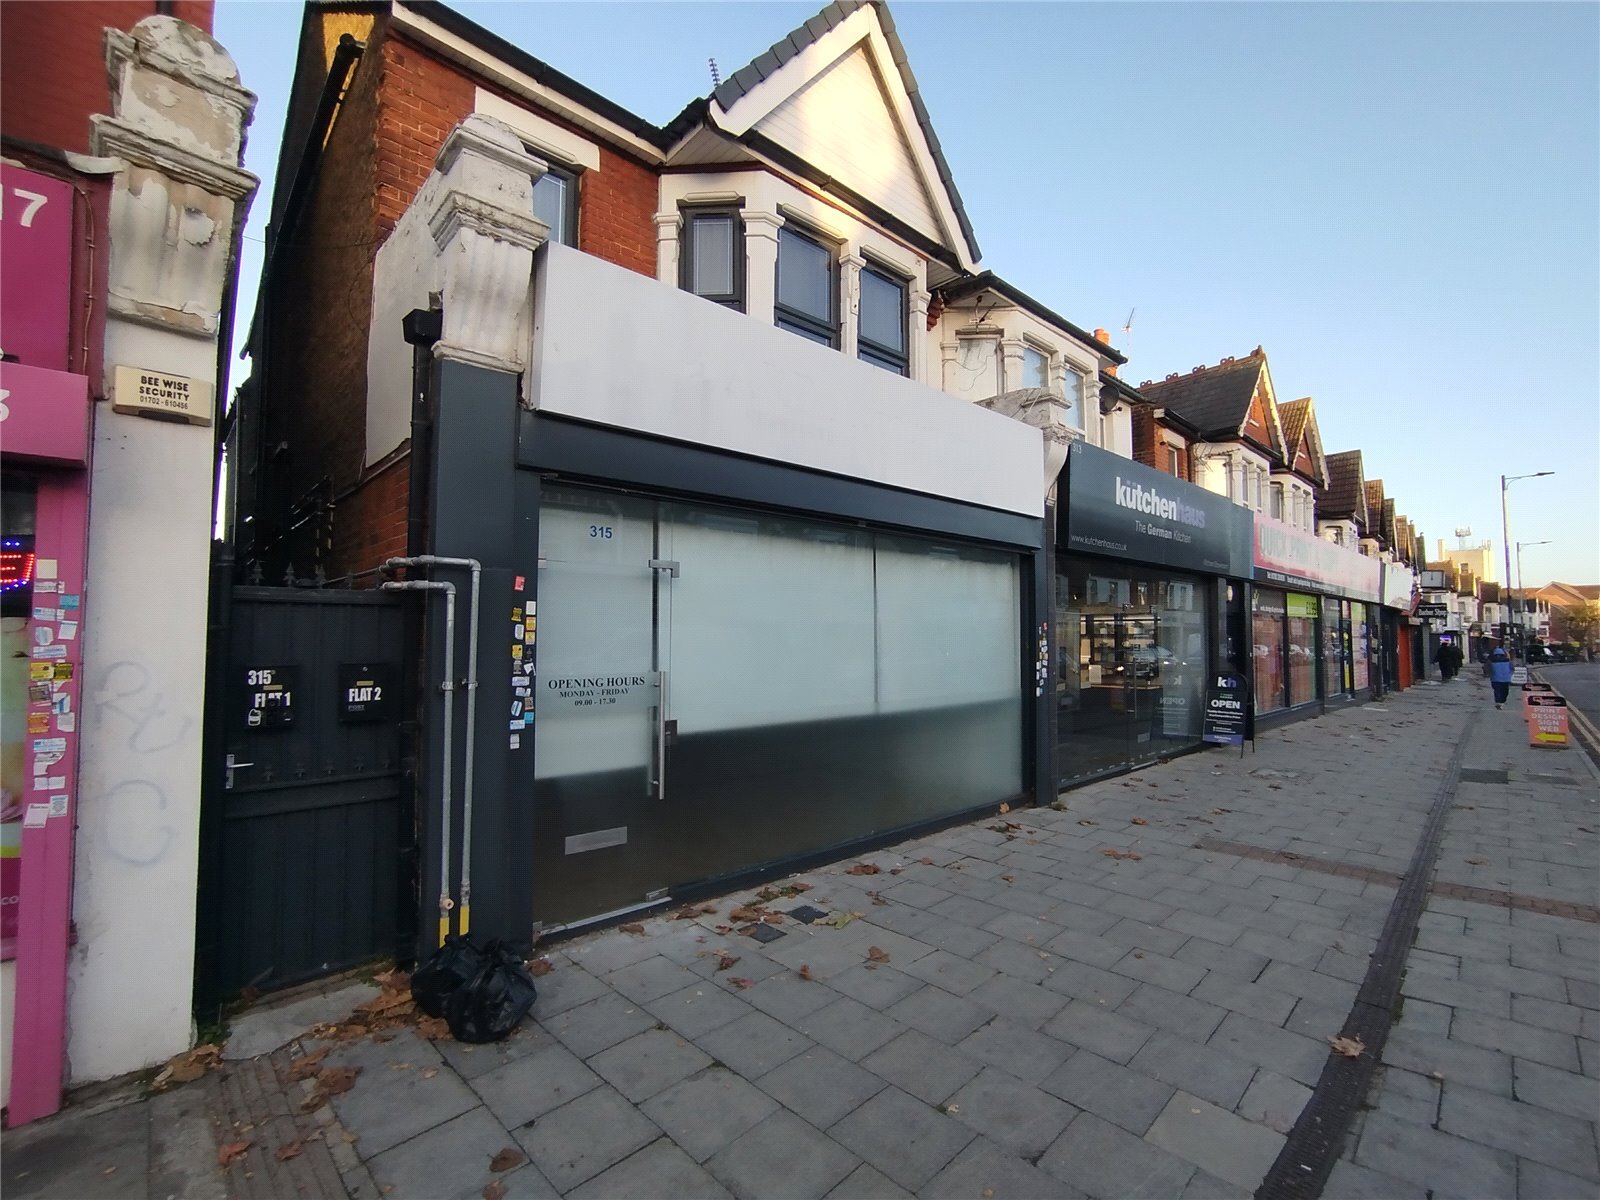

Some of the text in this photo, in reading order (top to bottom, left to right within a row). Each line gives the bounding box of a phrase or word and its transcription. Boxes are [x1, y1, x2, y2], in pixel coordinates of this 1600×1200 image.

[141, 376, 188, 391] BEE WISE
[139, 386, 189, 401] SECURITY
[590, 525, 613, 539] 315
[1135, 520, 1146, 533] The
[1147, 523, 1173, 540] German
[248, 670, 272, 686] 315
[548, 676, 646, 690] OPENING HOURS
[1217, 676, 1236, 687] kh
[284, 692, 291, 706] 1
[348, 687, 382, 702] FLAT 2
[559, 690, 595, 698] MONDAY
[601, 687, 630, 696] FRIDAY
[1211, 700, 1240, 709] OPEN
